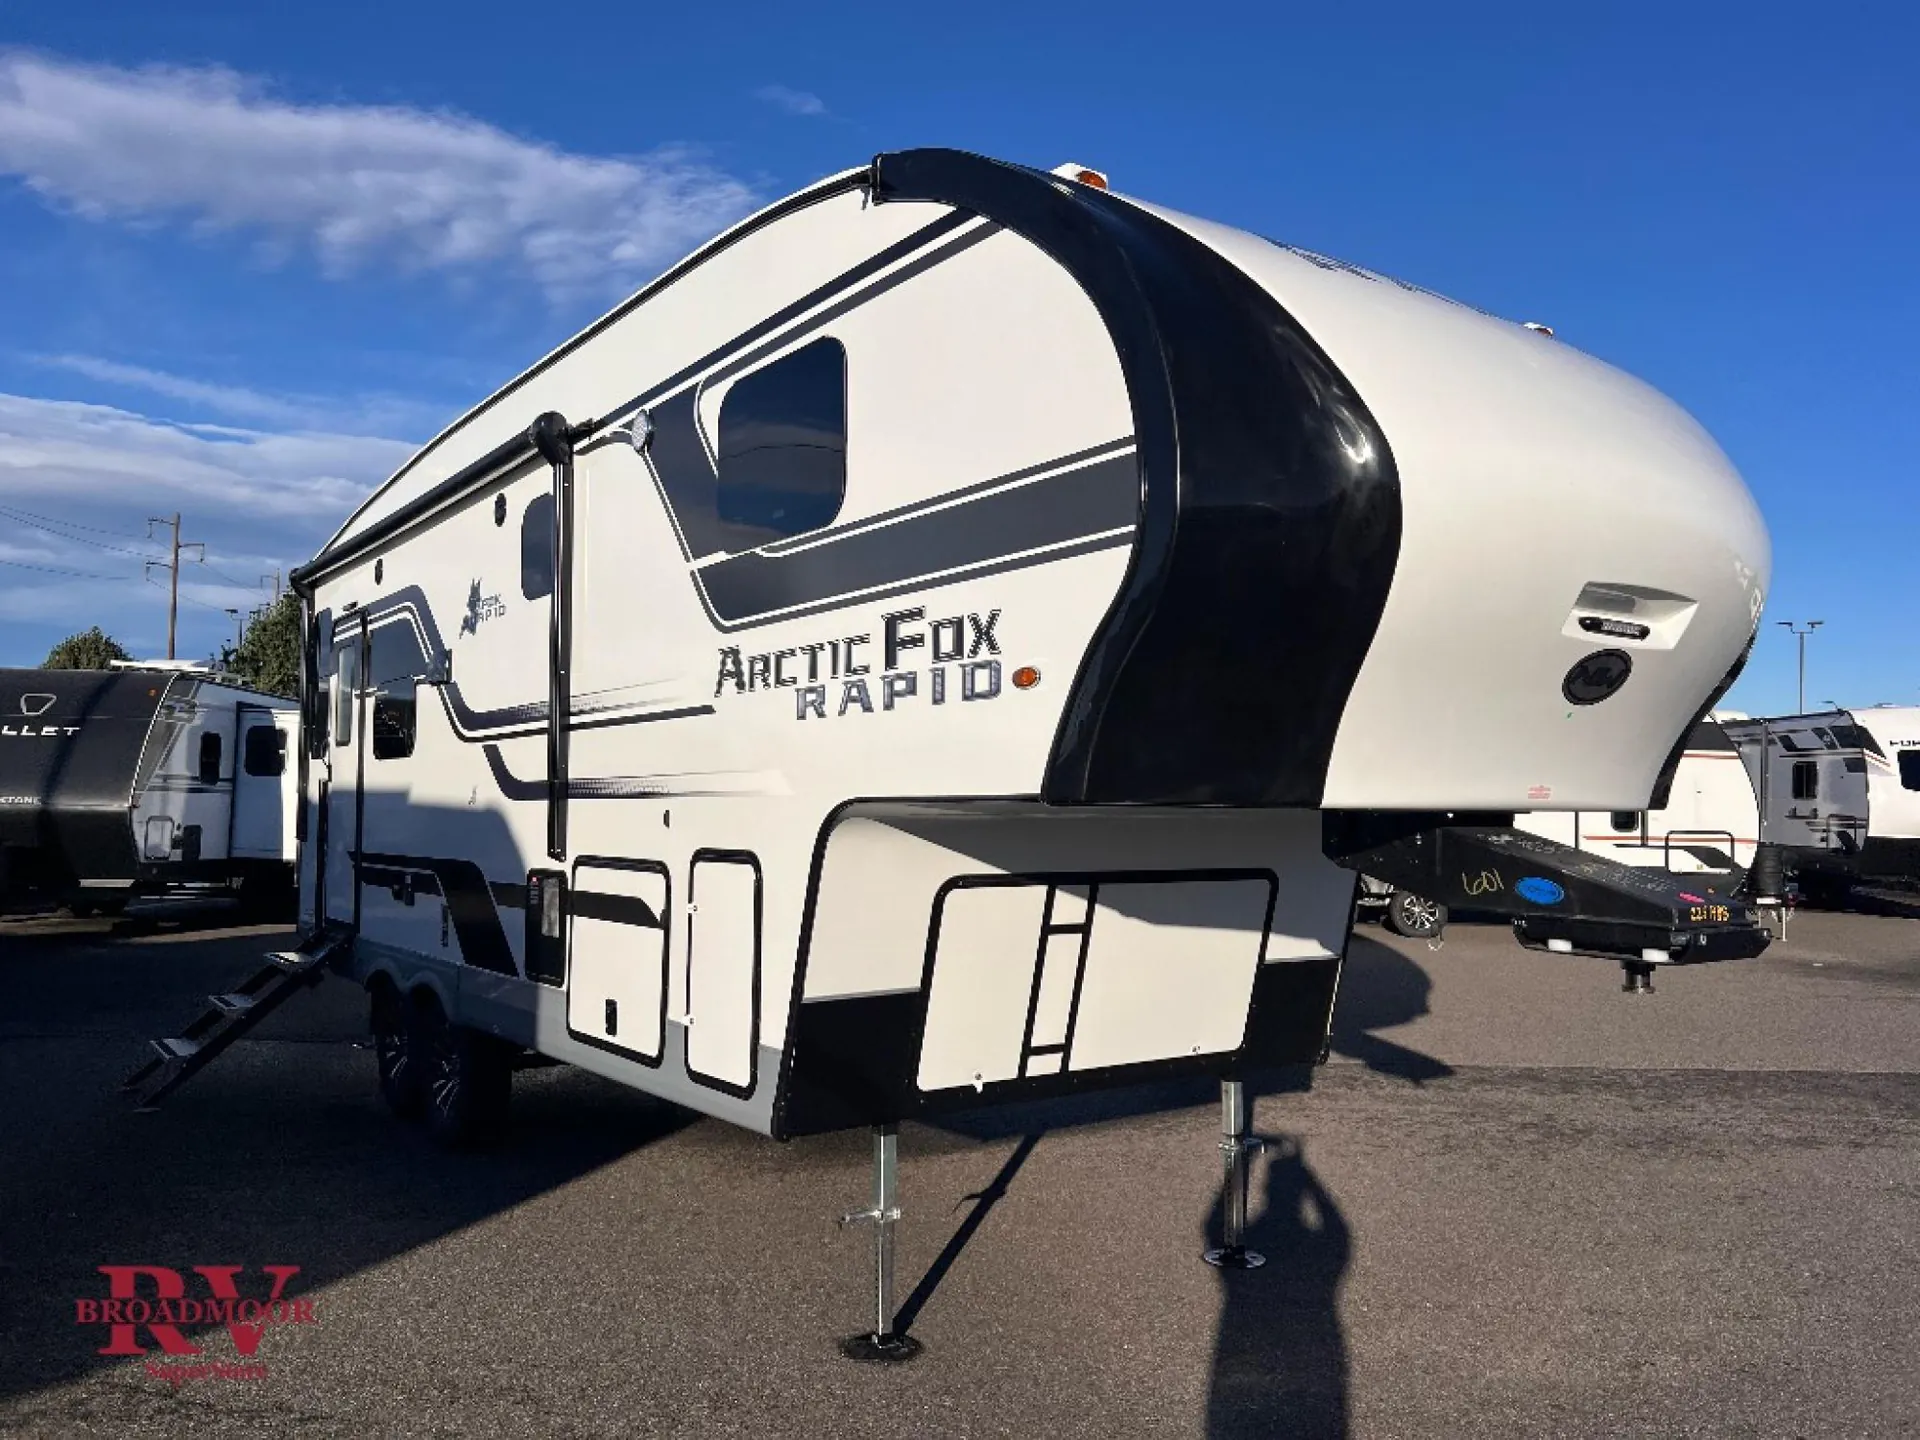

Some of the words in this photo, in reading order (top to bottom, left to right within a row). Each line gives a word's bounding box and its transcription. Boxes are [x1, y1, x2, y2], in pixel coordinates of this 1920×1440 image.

[714, 633, 870, 698] ARCTIC
[881, 605, 1002, 671] FOX
[795, 660, 1002, 720] RAPID
